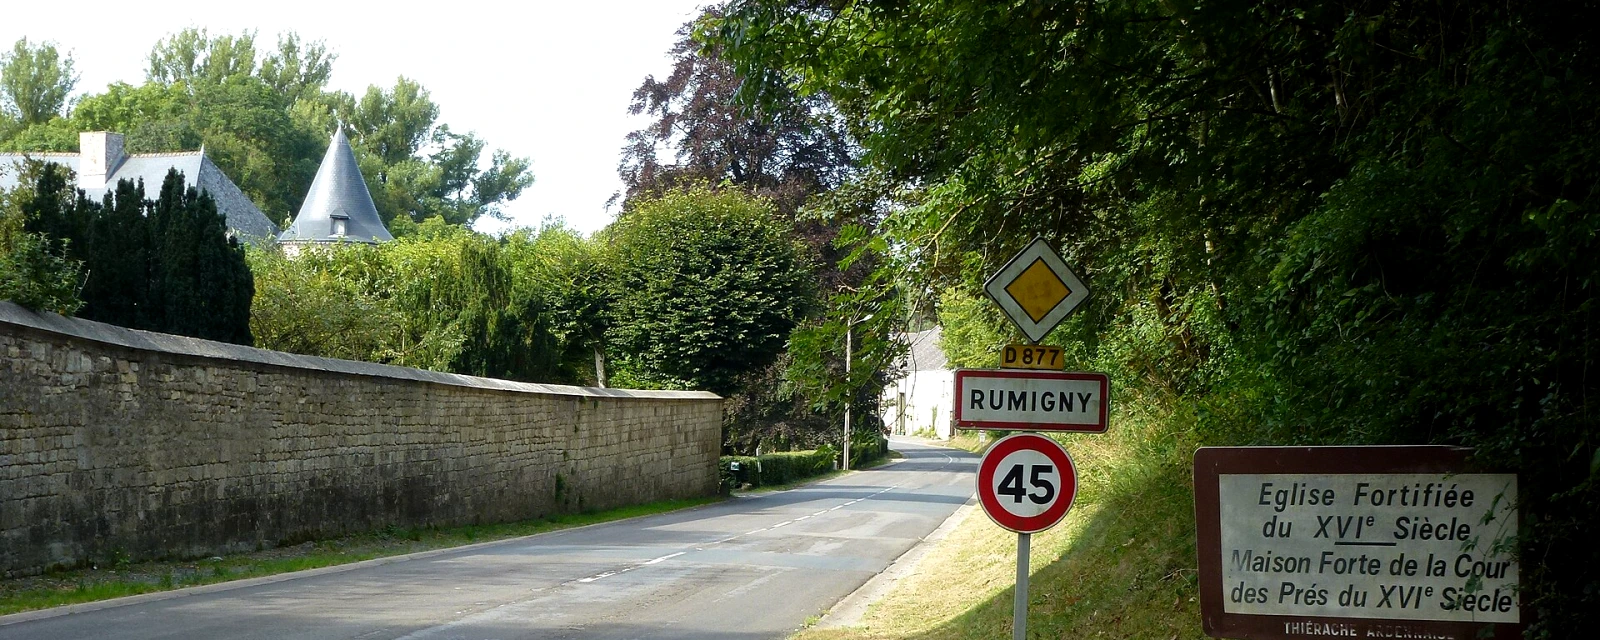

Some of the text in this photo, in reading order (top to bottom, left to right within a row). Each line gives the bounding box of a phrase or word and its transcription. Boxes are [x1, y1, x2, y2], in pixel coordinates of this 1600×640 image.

[1004, 347, 1060, 365] D 877
[970, 389, 1093, 413] RUMIGNY
[997, 464, 1055, 505] 45
[1258, 482, 1475, 513] Eglise Fortifiée
[1262, 516, 1293, 539] du
[1393, 516, 1472, 542] Siècle
[1231, 549, 1510, 580] Maison Forte de la Cour
[1230, 582, 1269, 604] des
[1277, 581, 1329, 606] Prés
[1338, 584, 1368, 608] du
[1283, 621, 1456, 640] THIÉRACHE ARDENNA
